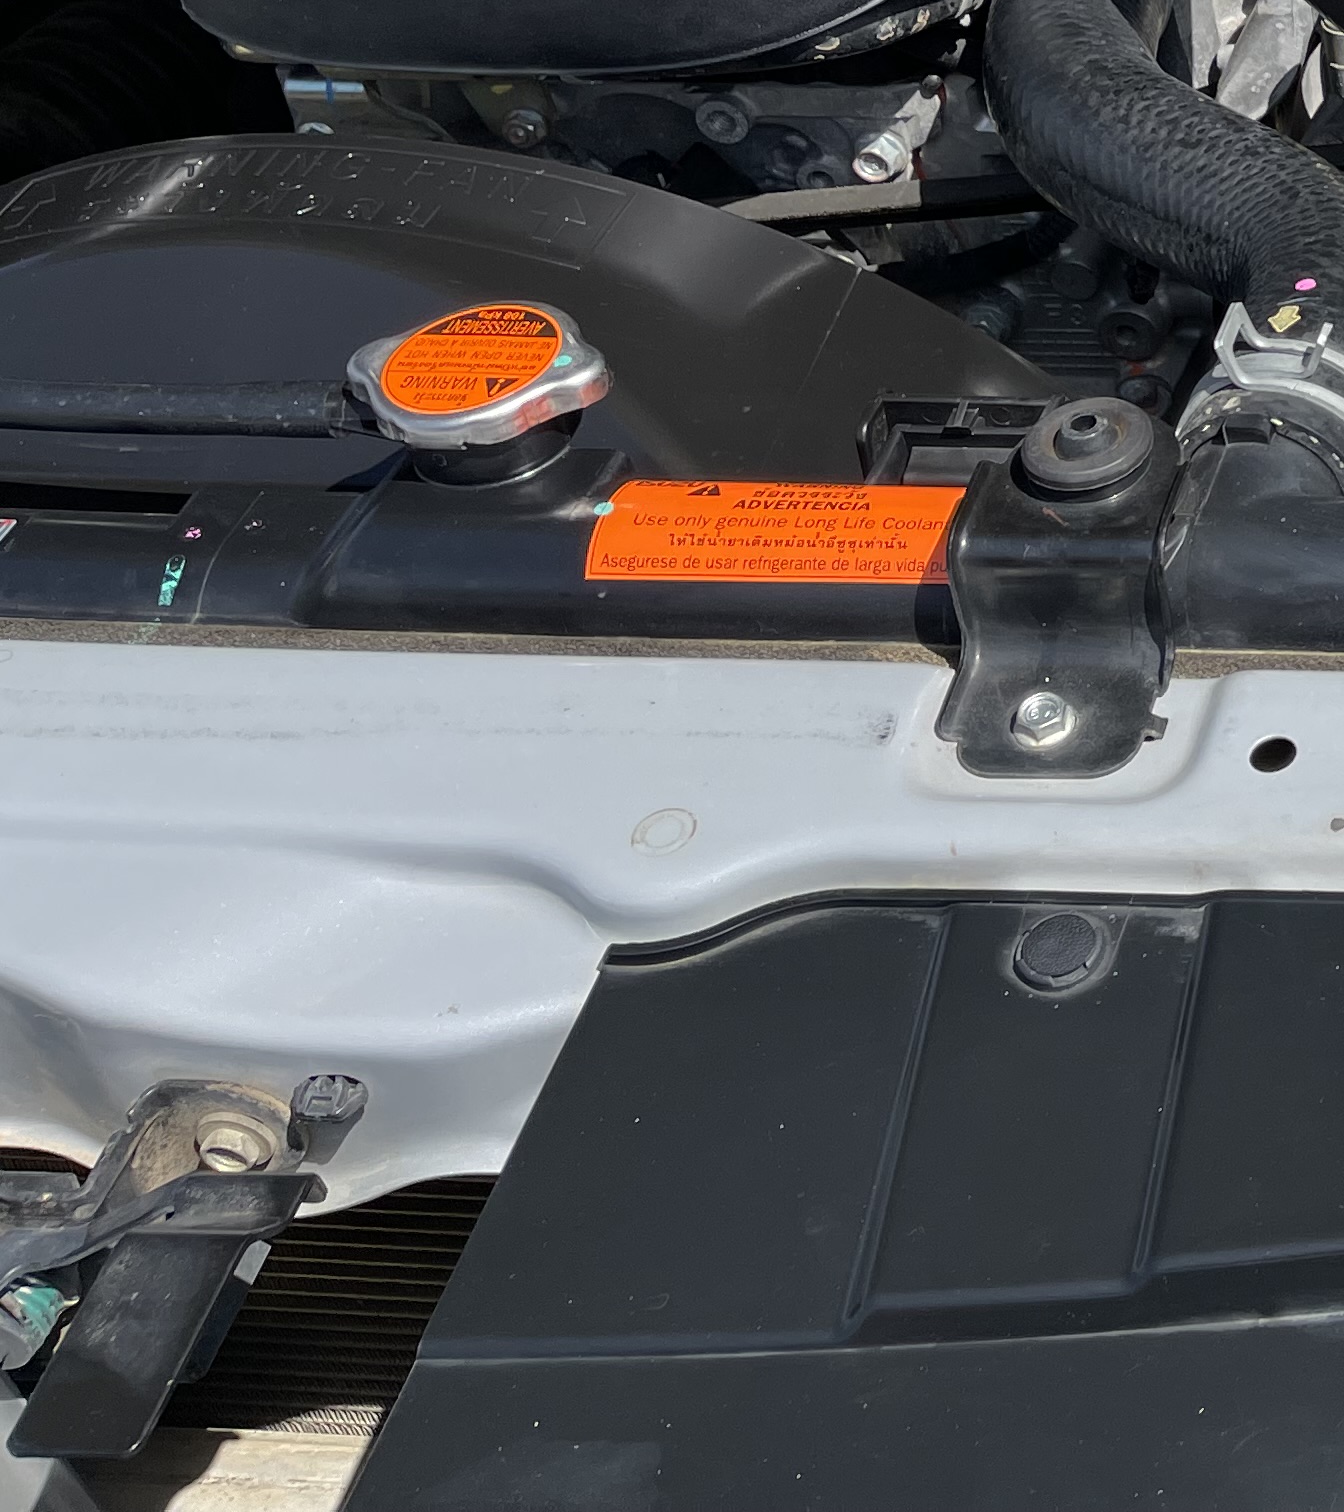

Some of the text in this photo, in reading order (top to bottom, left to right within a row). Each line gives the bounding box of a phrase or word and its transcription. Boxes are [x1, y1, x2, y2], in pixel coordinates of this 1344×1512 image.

[440, 318, 546, 334] AVERTISSEMENT
[432, 349, 467, 360] WHEN
[471, 351, 503, 361] OPEN
[503, 351, 544, 362] NEVER
[399, 374, 479, 392] WARNING
[732, 499, 871, 511] ADVERTENCIA
[633, 513, 669, 527] Use
[673, 514, 711, 531] only
[714, 514, 787, 531] genuine
[794, 514, 836, 532] Long
[843, 514, 876, 529] Life
[600, 553, 678, 573] Asegurese
[682, 555, 700, 569] de
[705, 557, 738, 571] usar
[742, 556, 827, 574] refrigerante
[831, 557, 850, 571] de
[854, 558, 891, 575] larga
[895, 558, 926, 573] vida
